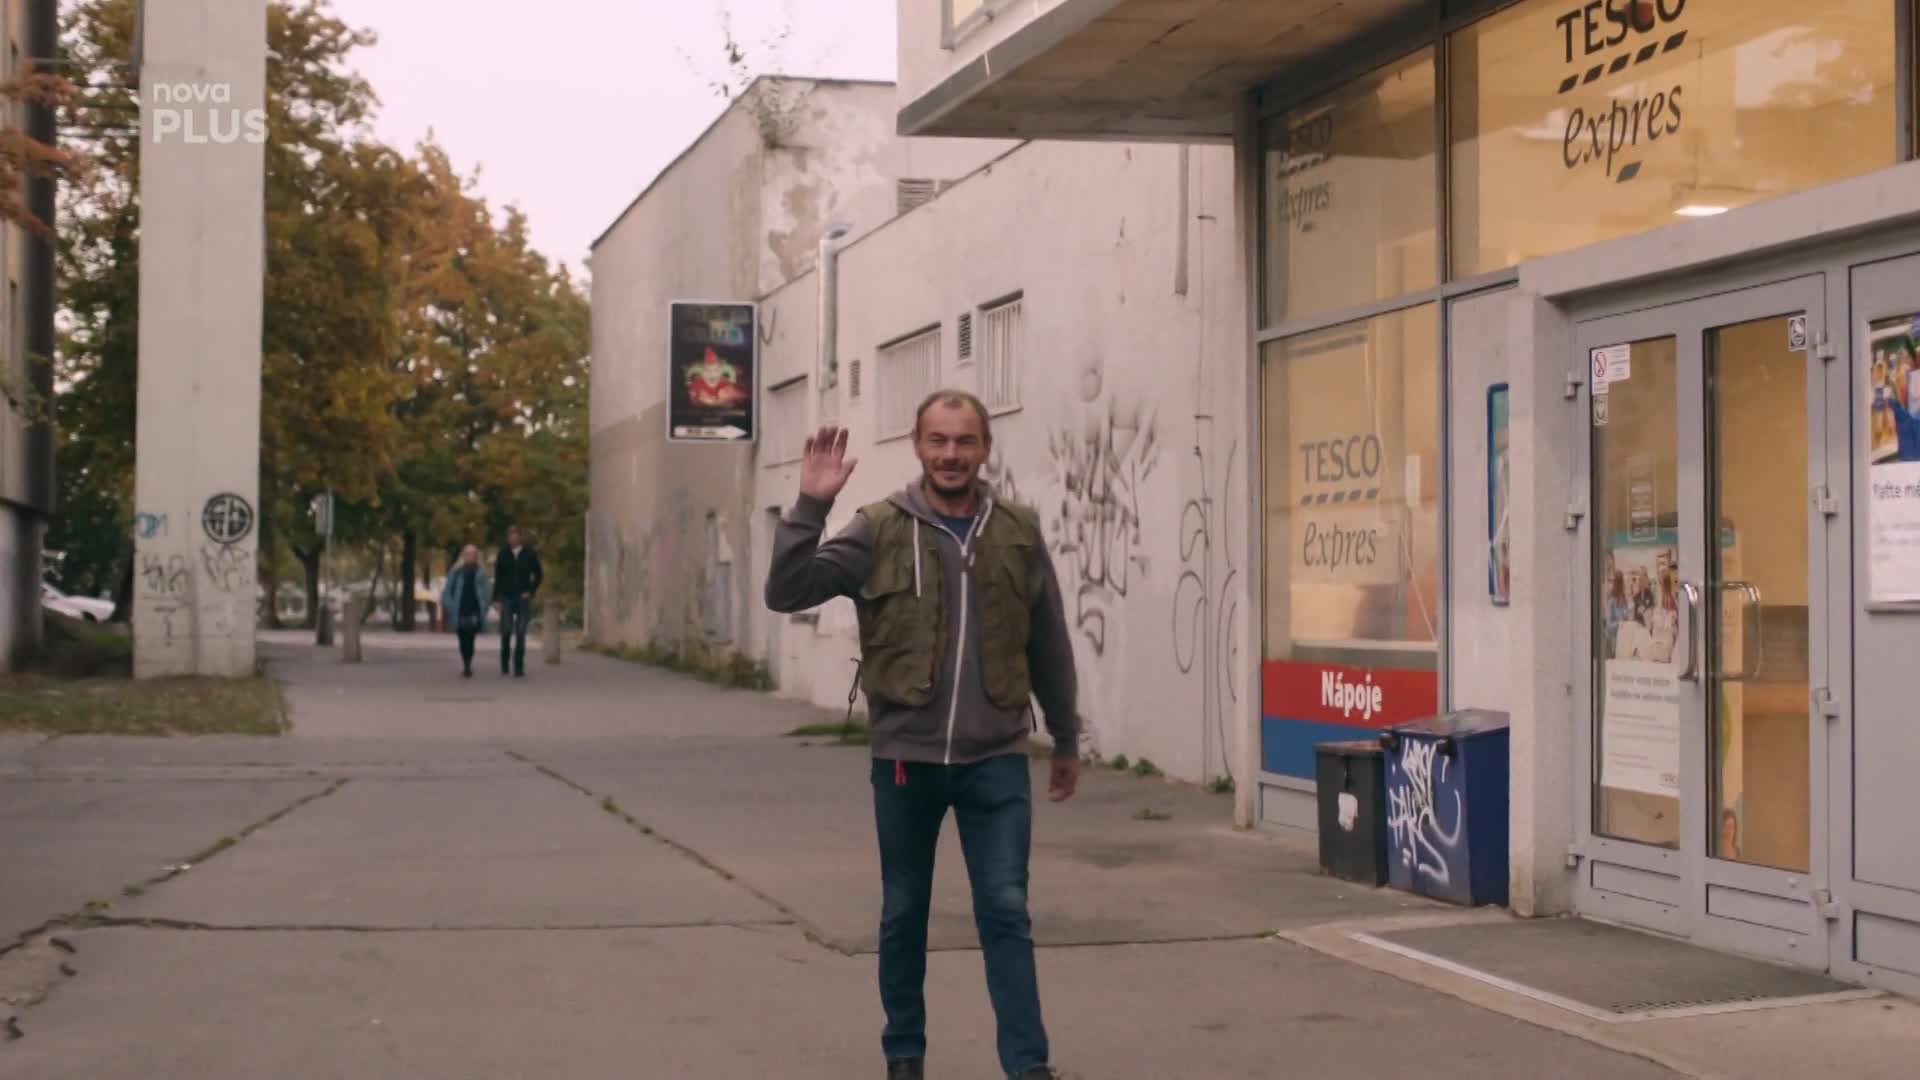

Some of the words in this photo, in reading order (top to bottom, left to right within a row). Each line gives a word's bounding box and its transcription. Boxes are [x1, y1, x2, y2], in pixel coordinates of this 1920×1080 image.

[1556, 0, 1687, 63] TESCO
[1563, 85, 1682, 177] expres
[1300, 434, 1380, 483] TESCO
[1303, 521, 1377, 573] expres
[1321, 670, 1382, 720] Nápoje
